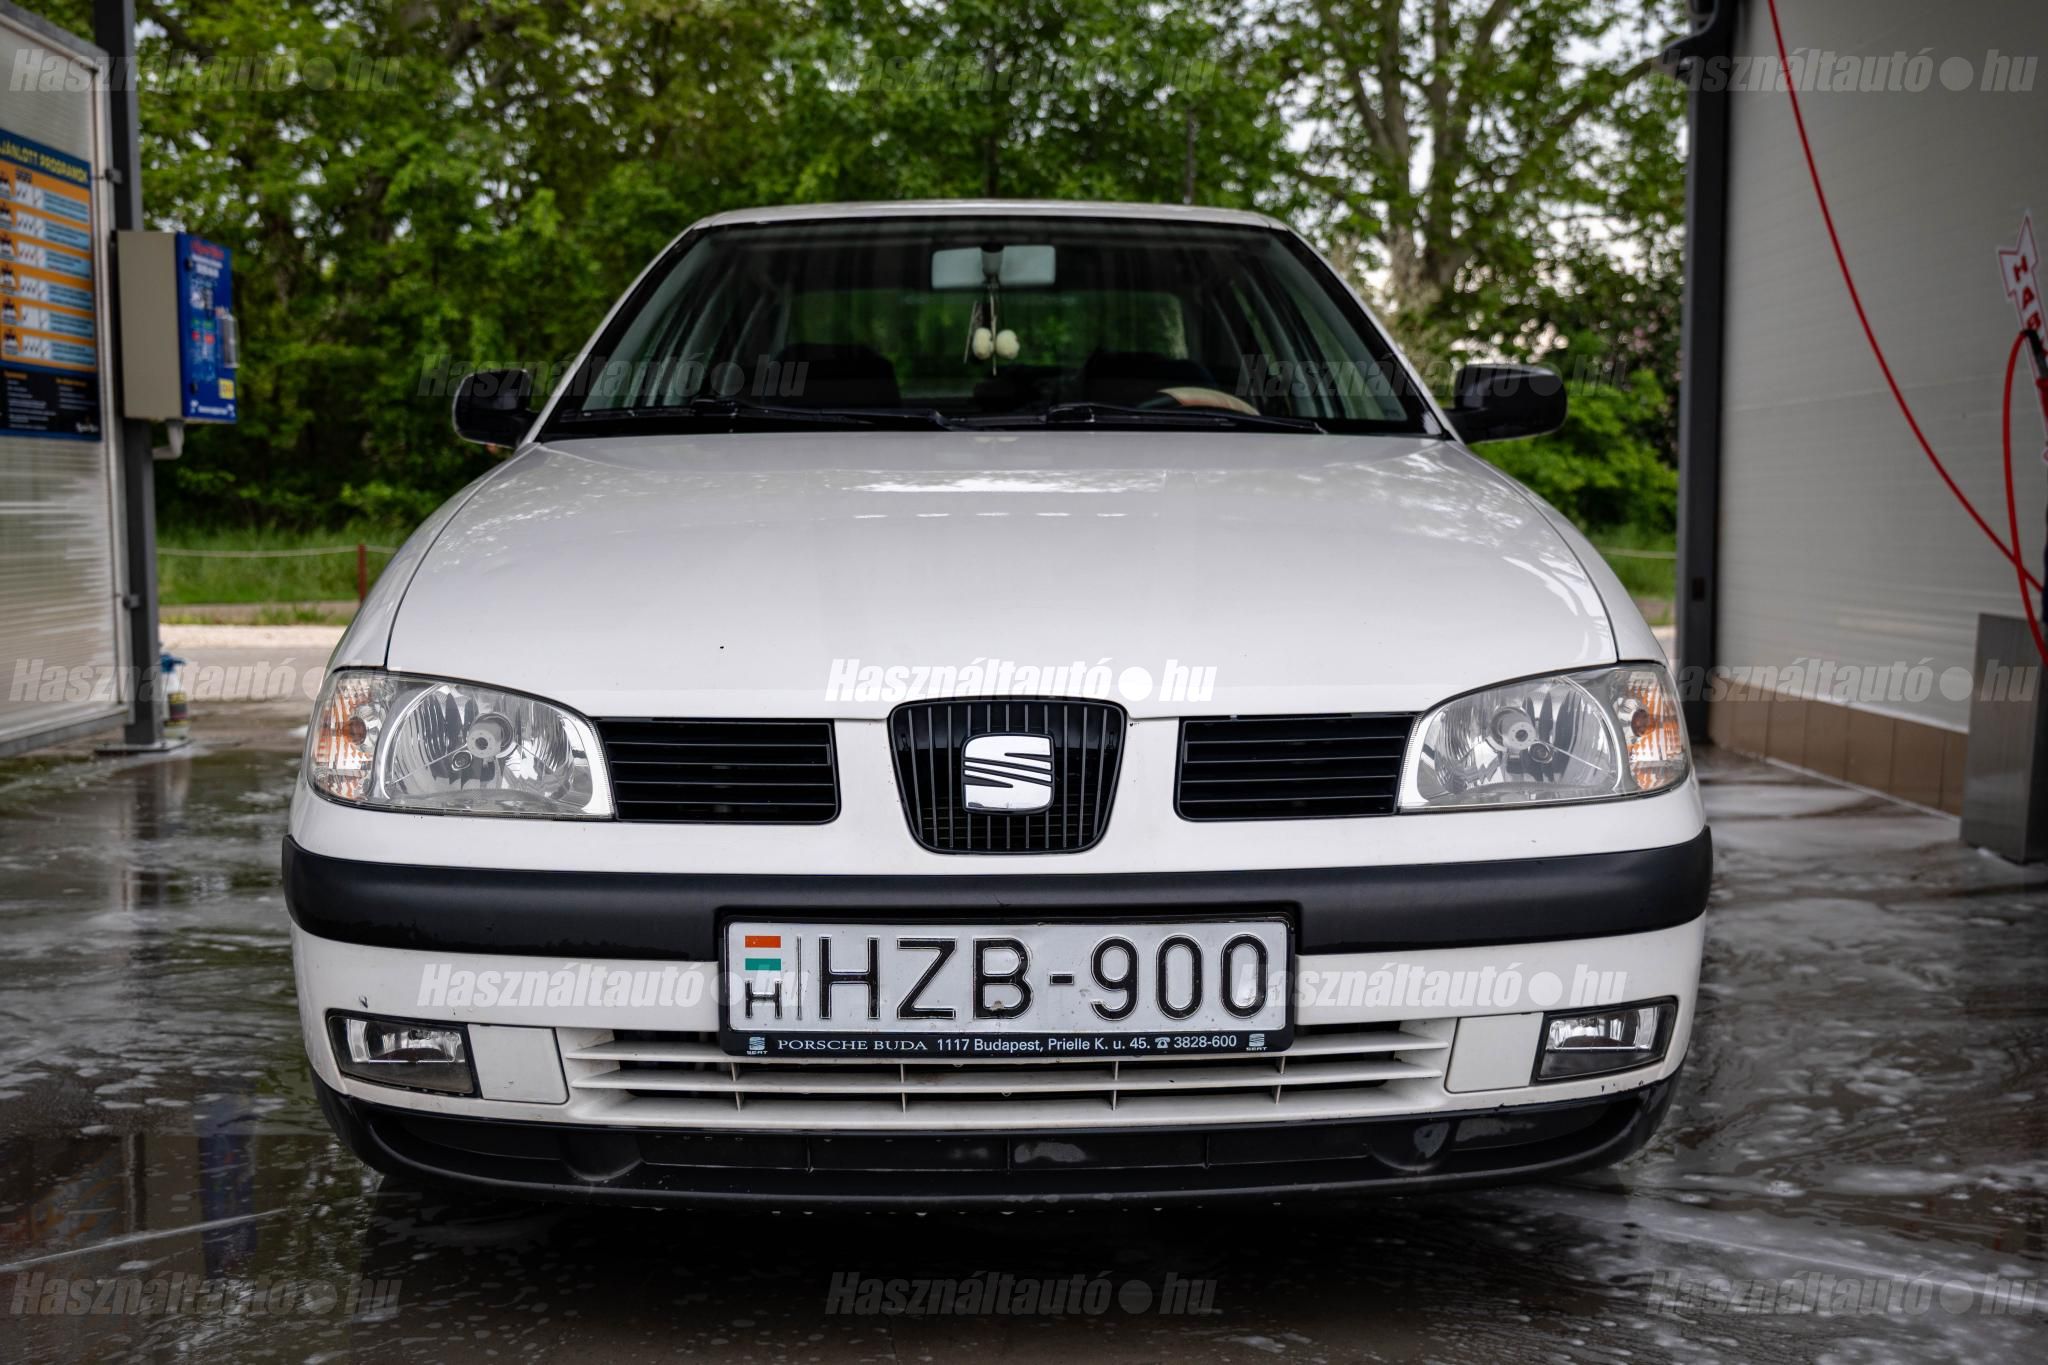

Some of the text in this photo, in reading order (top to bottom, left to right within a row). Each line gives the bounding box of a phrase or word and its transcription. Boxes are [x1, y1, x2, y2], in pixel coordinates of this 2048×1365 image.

[818, 934, 1269, 1022] HZB-900
[744, 980, 783, 1019] H
[777, 1034, 1238, 1054] PORSCHE BUDA 1117 Budapest, Prielle K. u. 45. 3828-600
